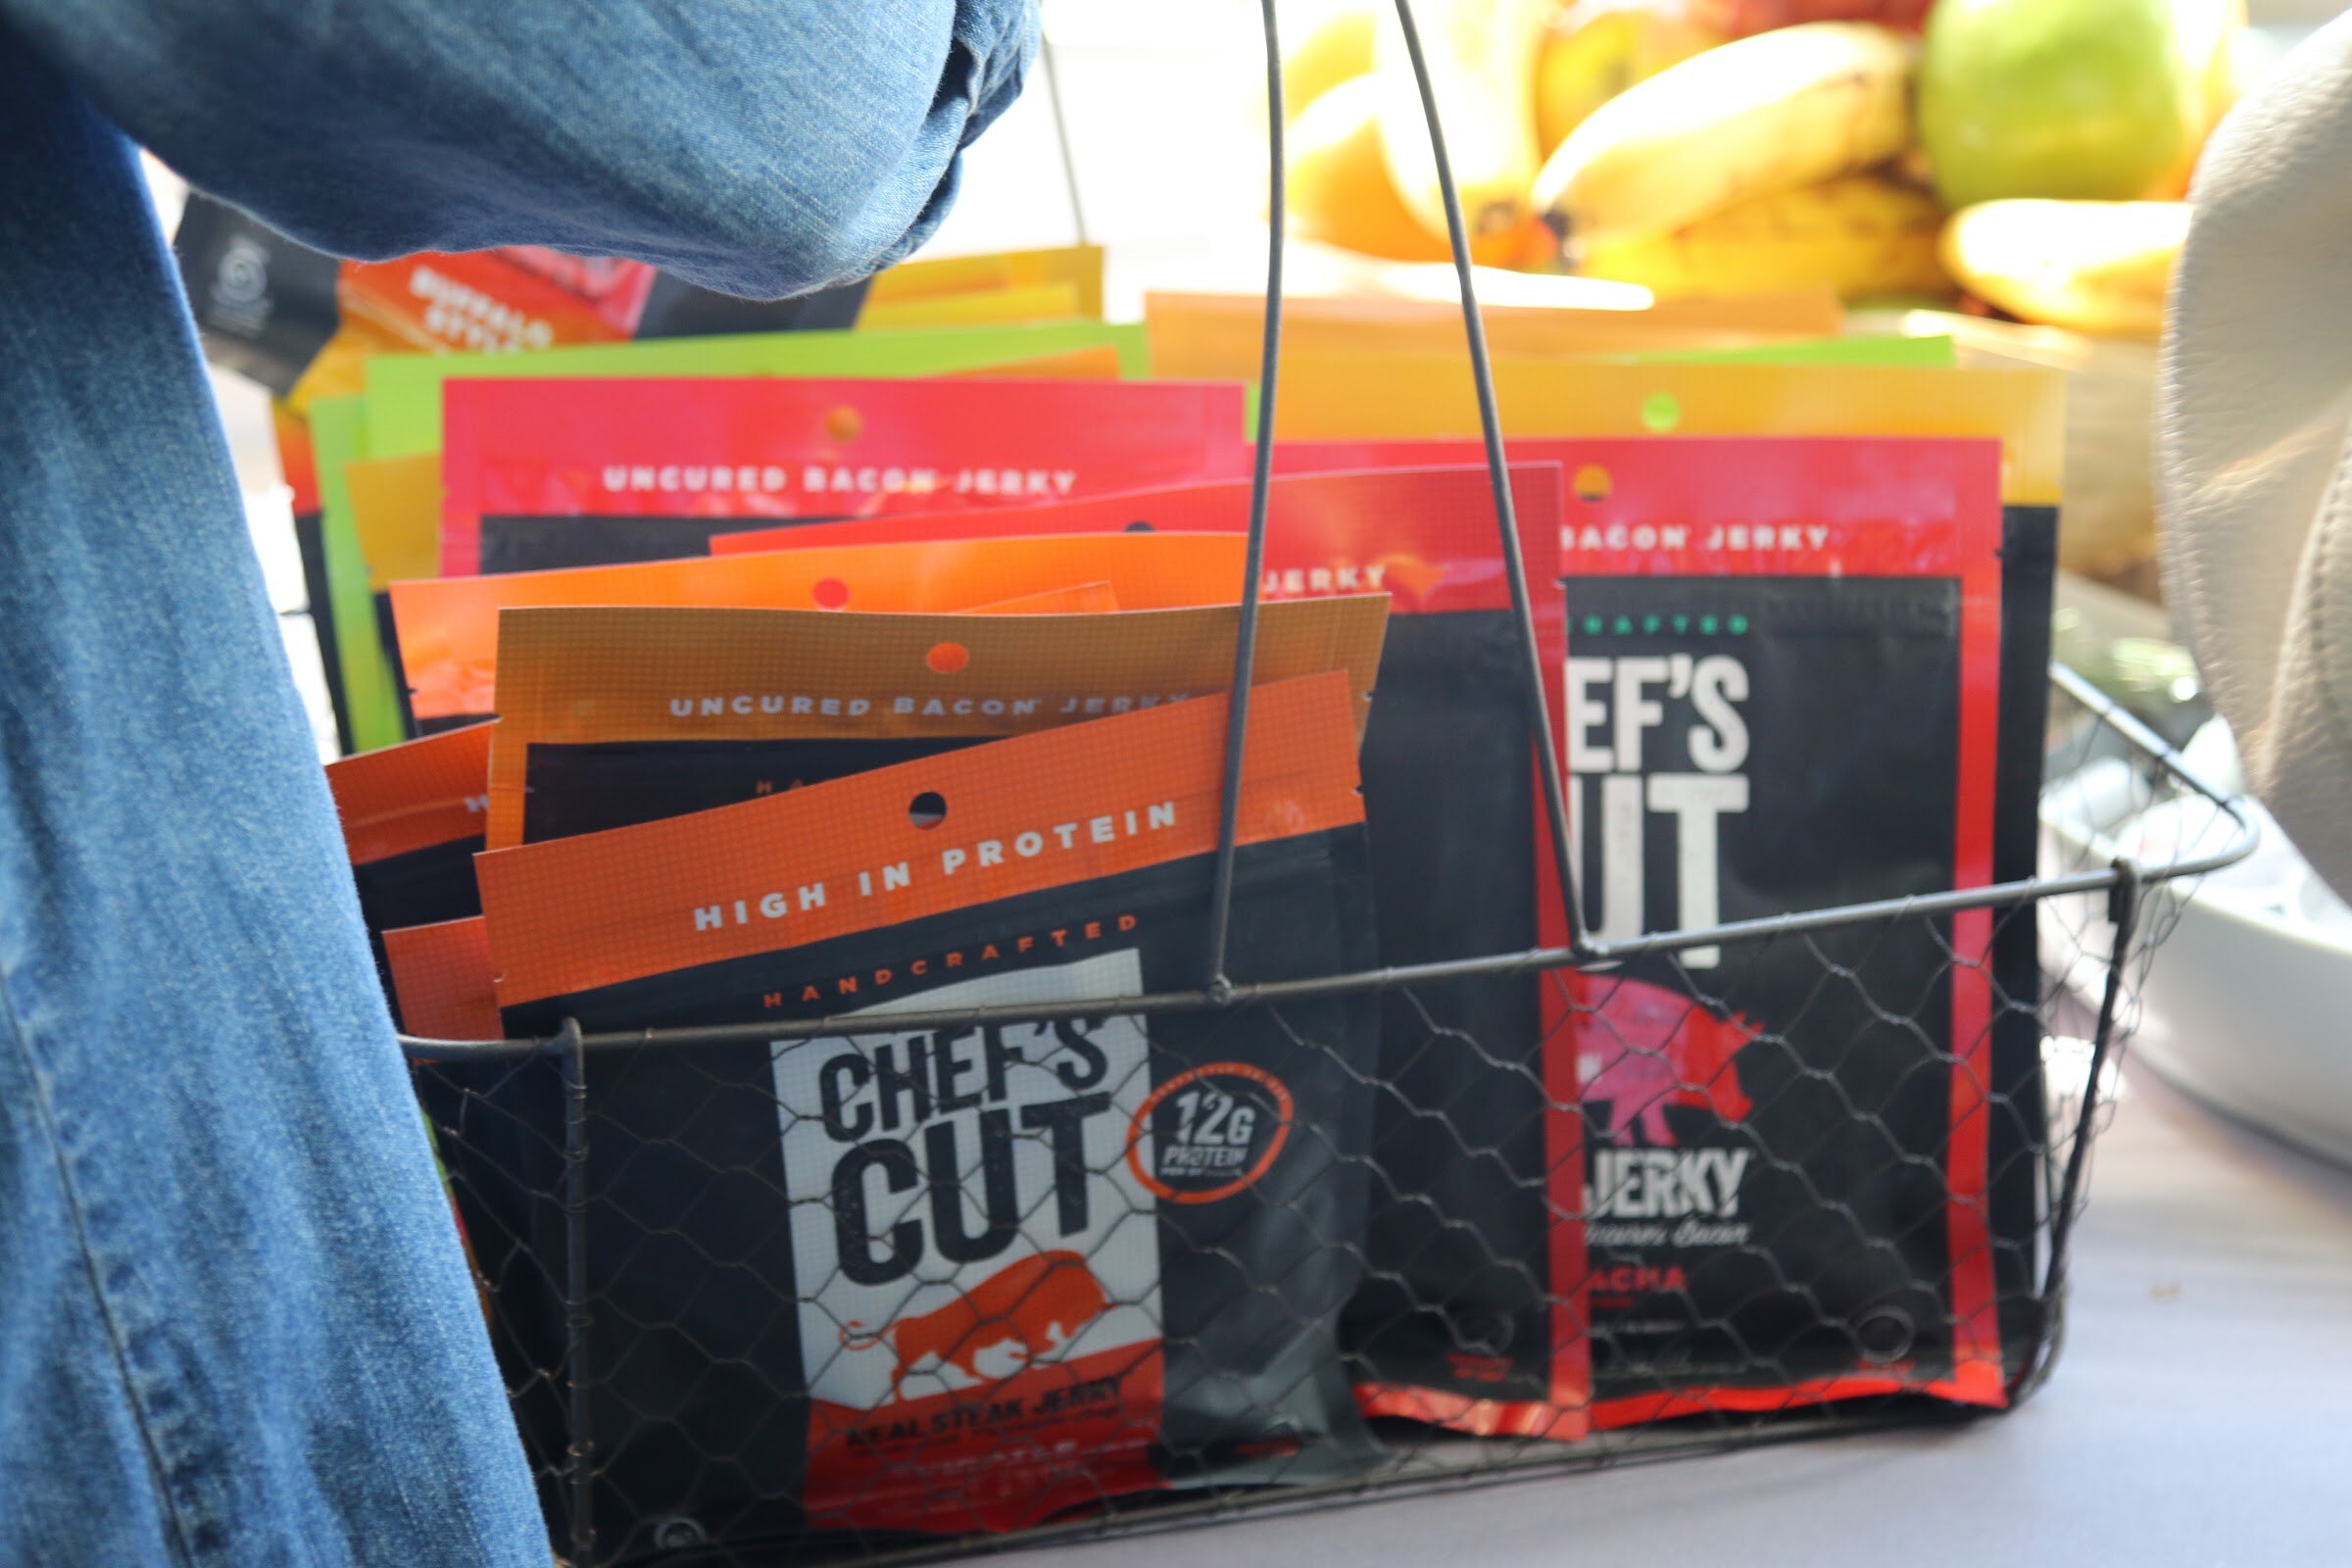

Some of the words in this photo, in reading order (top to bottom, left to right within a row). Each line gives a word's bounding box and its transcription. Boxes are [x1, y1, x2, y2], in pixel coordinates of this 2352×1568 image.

[602, 466, 786, 492] UNCURED
[803, 467, 935, 494] BACON
[955, 469, 1076, 495] JERKY
[1707, 523, 1830, 552] JERKY
[1264, 564, 1388, 594] JERKY
[1569, 613, 1749, 635] RAFTED
[670, 695, 871, 717] UNCURED
[893, 697, 1037, 716] BACON
[1565, 654, 1749, 773] EF'S
[694, 882, 826, 931] HIGH
[858, 861, 910, 897] IN
[942, 801, 1176, 875] PROTEIN
[1570, 770, 1750, 969] UT
[763, 913, 1138, 1009] HANDCRAFTED
[818, 1015, 1108, 1144] CHEF'S
[1174, 1089, 1255, 1146] 12G
[831, 1090, 1110, 1287] CUT
[1582, 1147, 1750, 1218] JERKY
[1588, 1265, 1687, 1292] ACHA
